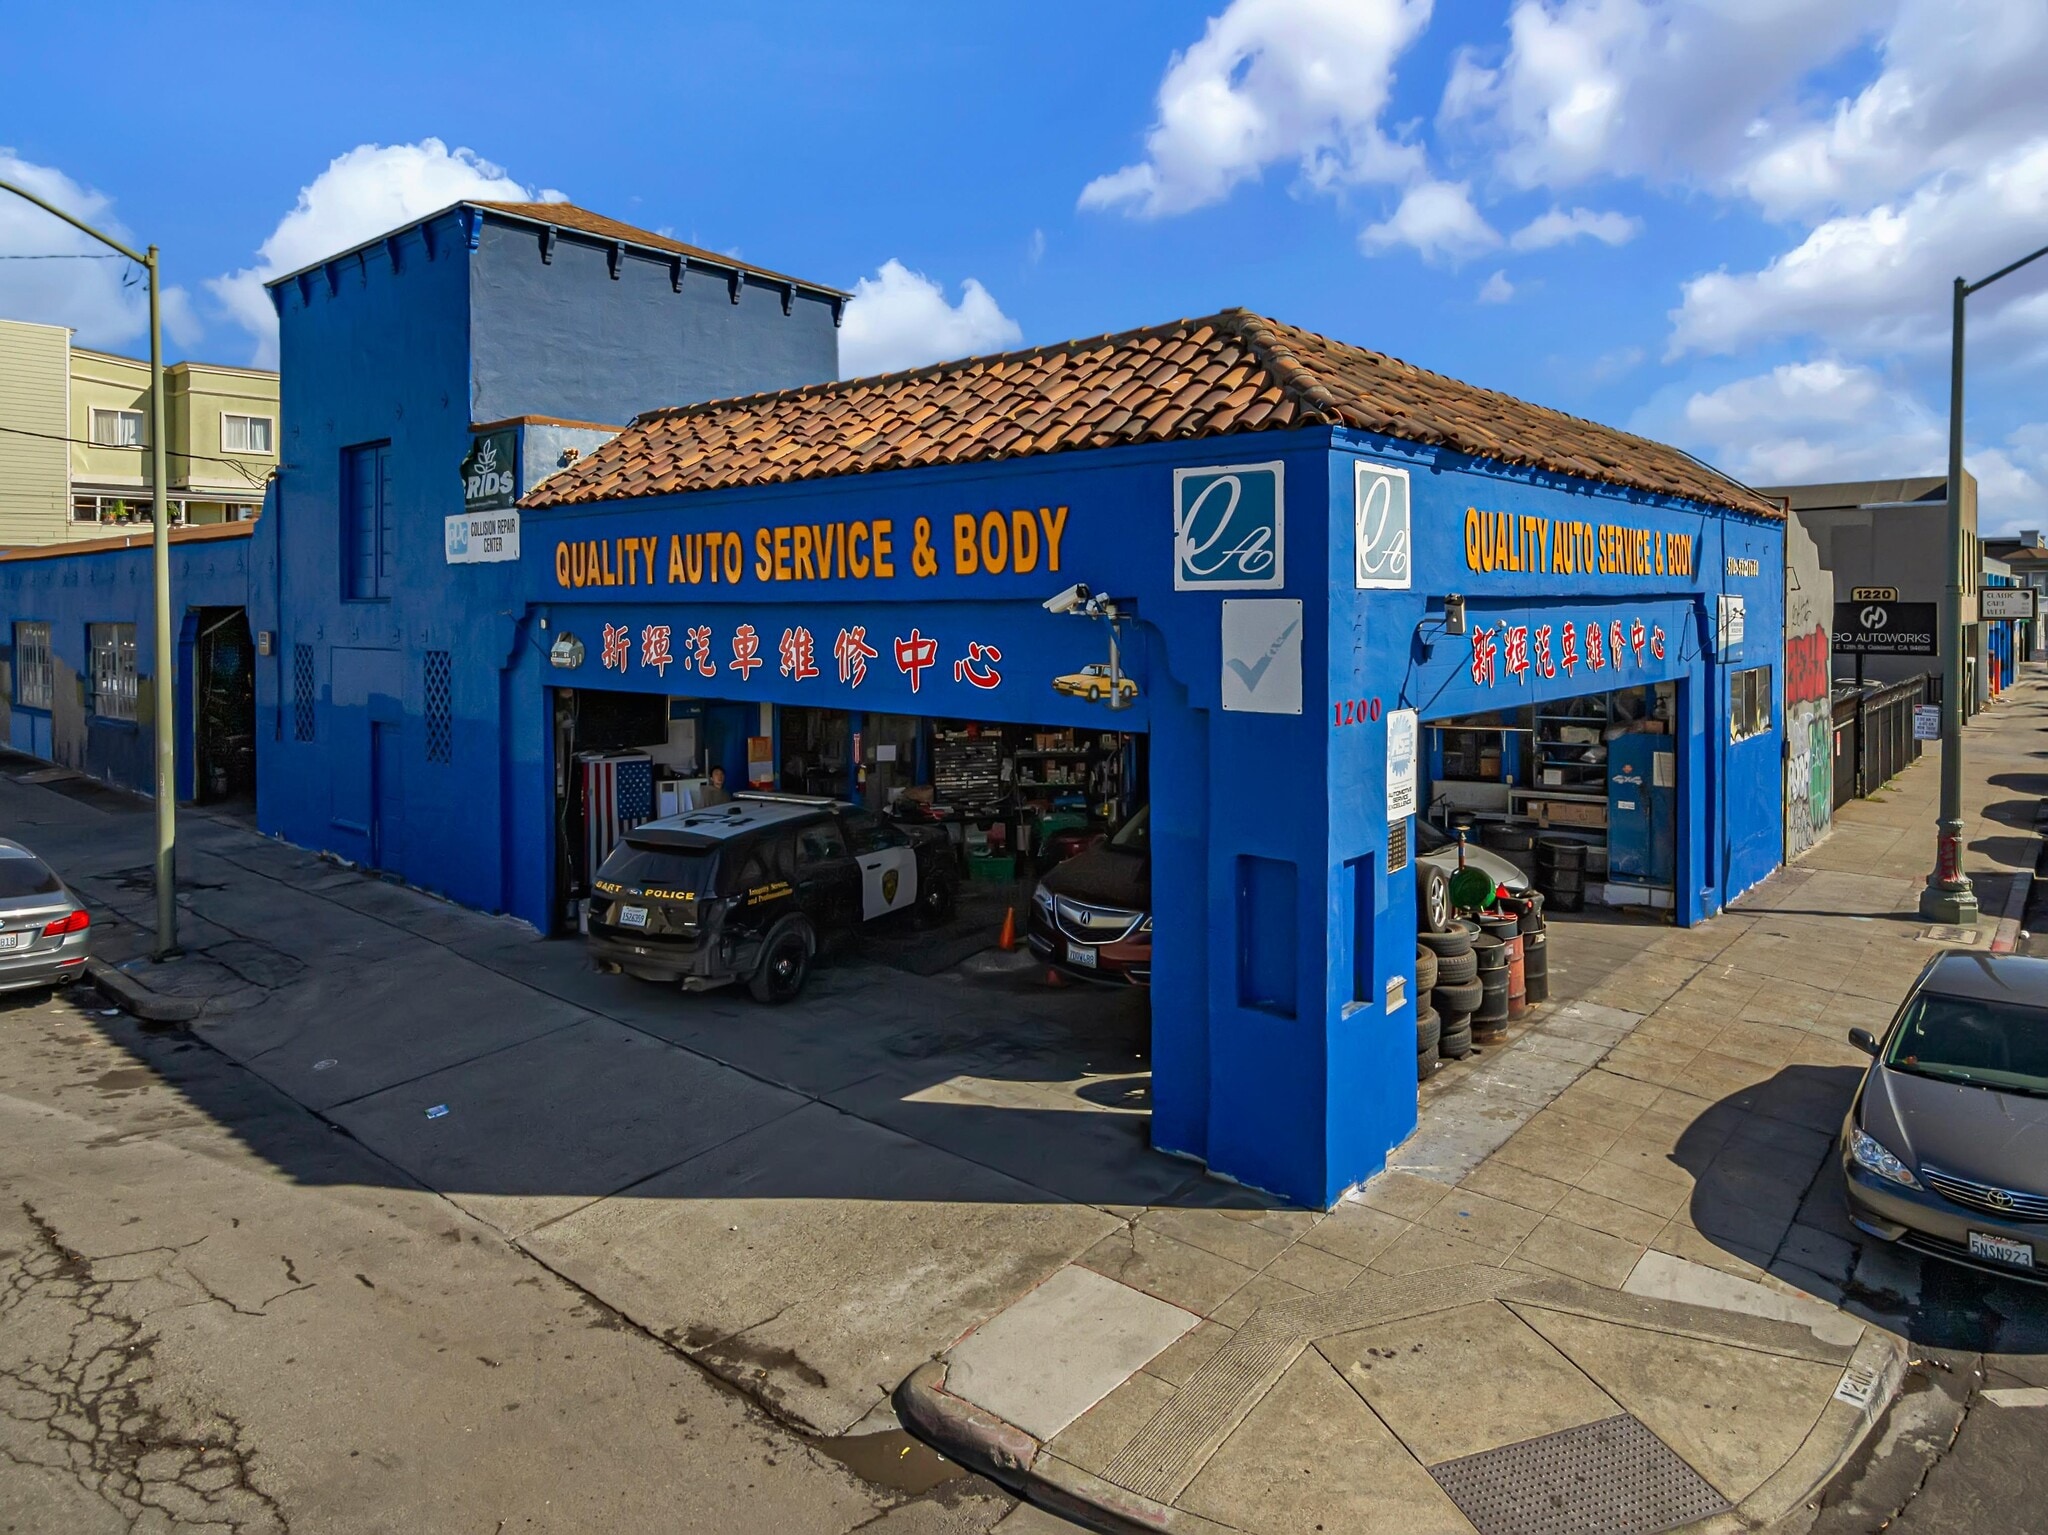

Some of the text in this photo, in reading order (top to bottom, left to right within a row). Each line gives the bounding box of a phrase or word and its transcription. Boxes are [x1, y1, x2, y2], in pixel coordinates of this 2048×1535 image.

[470, 518, 516, 537] COLLISION REPAIR
[483, 537, 503, 553] CENTER
[556, 506, 1069, 589] QUALITY AUTO SERVICE & BODY
[1464, 506, 1693, 576] QUALITY AUTO SERVICE & BODY
[1856, 590, 1891, 599] 1220
[1856, 632, 1931, 644] AUTOWORKS
[601, 622, 1002, 694] 新輝汽車維修中心
[1471, 617, 1666, 689] 新輝汽車維修中心
[1334, 696, 1382, 727] 1200
[1388, 786, 1412, 798] AUTOMOTIVE
[1393, 794, 1409, 803] SERVICE
[644, 888, 695, 900] POLICE
